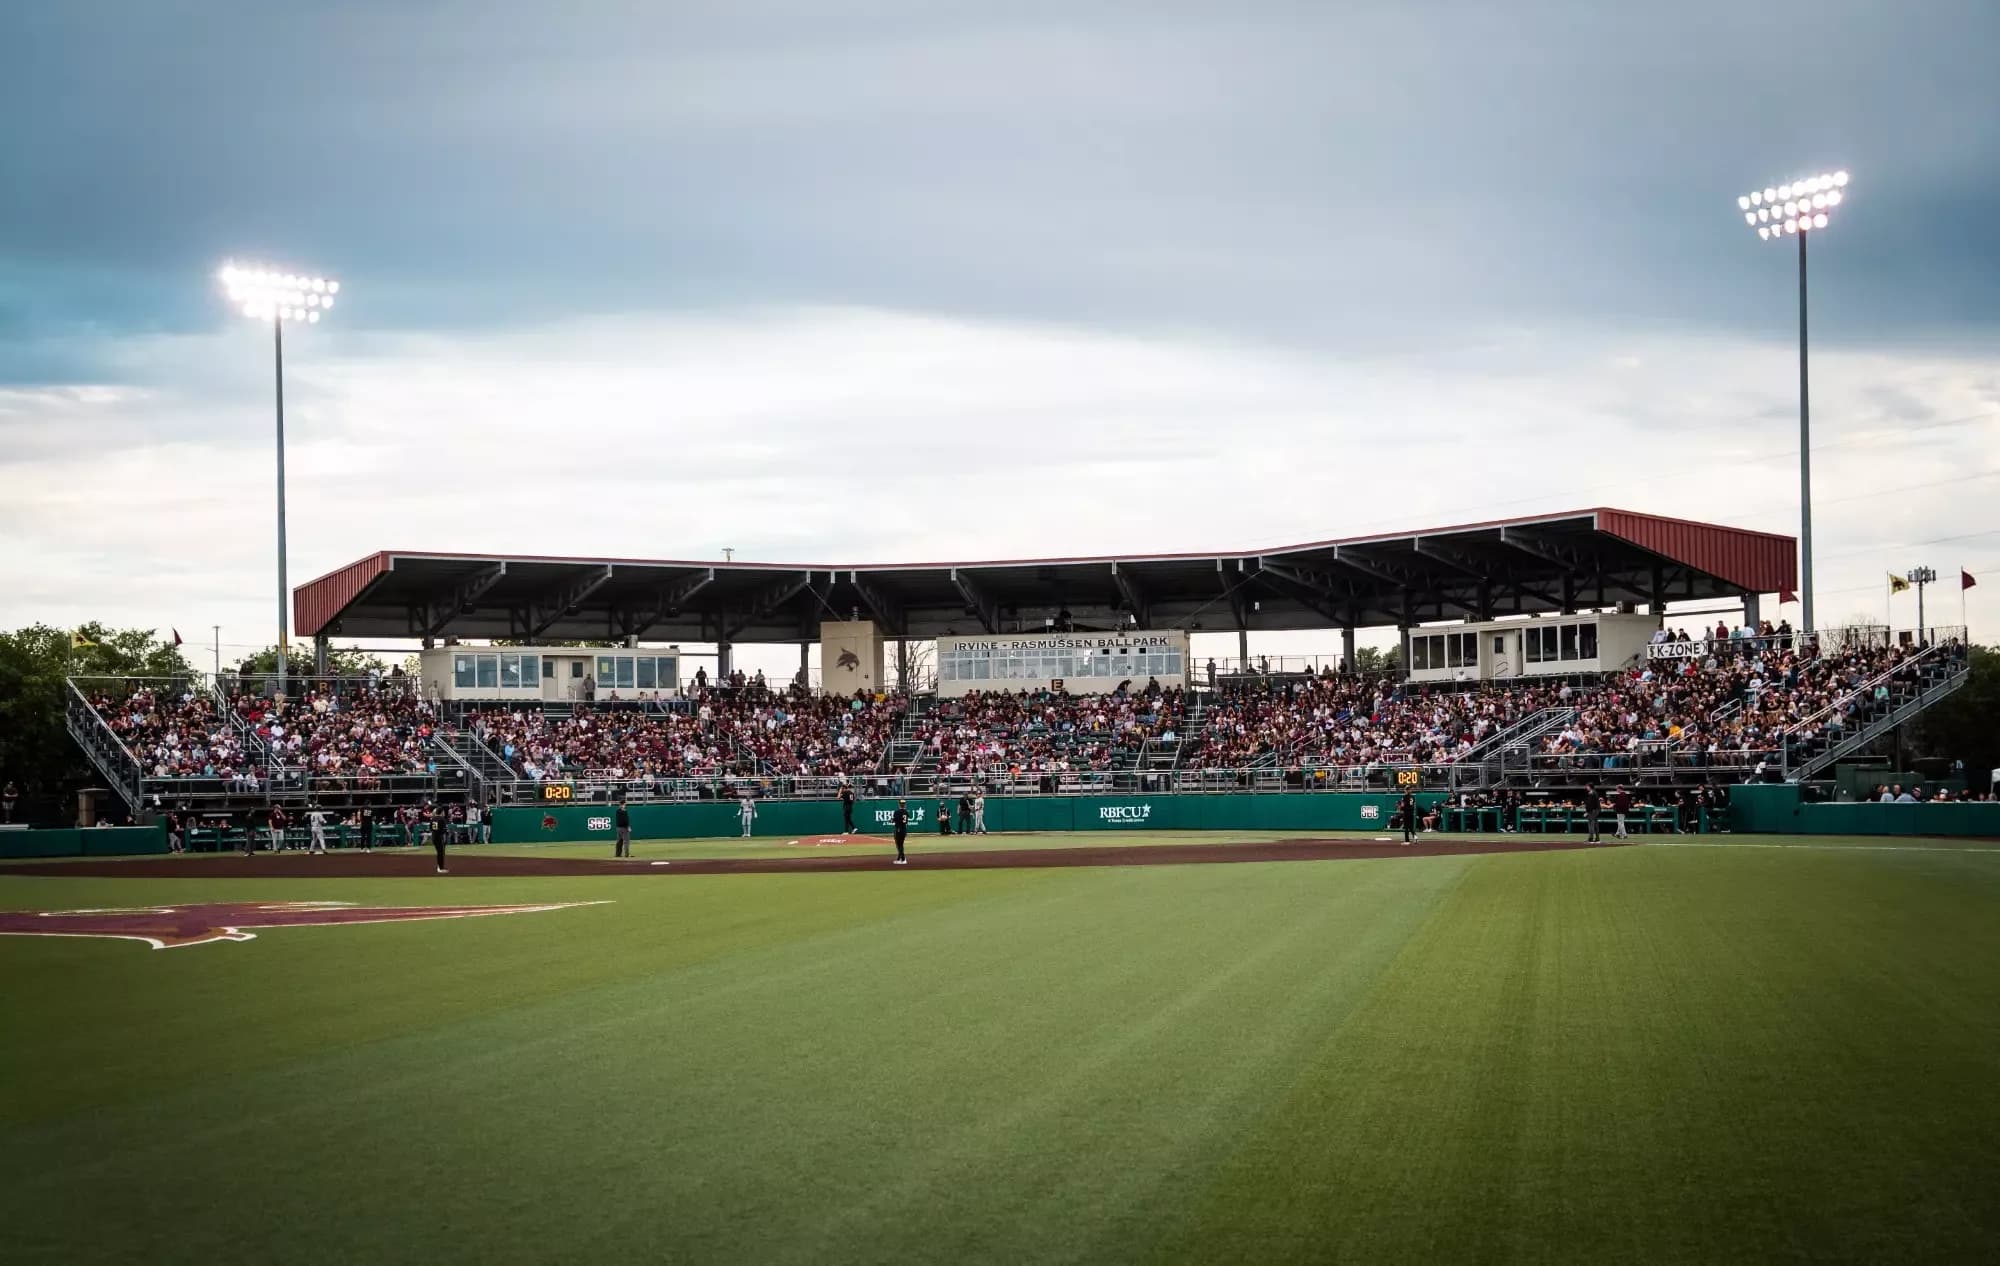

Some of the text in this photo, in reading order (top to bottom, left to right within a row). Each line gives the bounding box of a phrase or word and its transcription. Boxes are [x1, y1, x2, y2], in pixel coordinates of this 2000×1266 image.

[954, 641, 998, 651] IRVINE
[1012, 639, 1092, 649] RASMUSSEN
[1097, 637, 1168, 647] BALLPARK
[1657, 642, 1701, 657] K-ZONE
[1053, 680, 1063, 691] E
[1398, 772, 1417, 784] 0:20
[545, 787, 570, 799] 0:20
[875, 810, 915, 822] RBU
[1099, 806, 1141, 818] RBFCU
